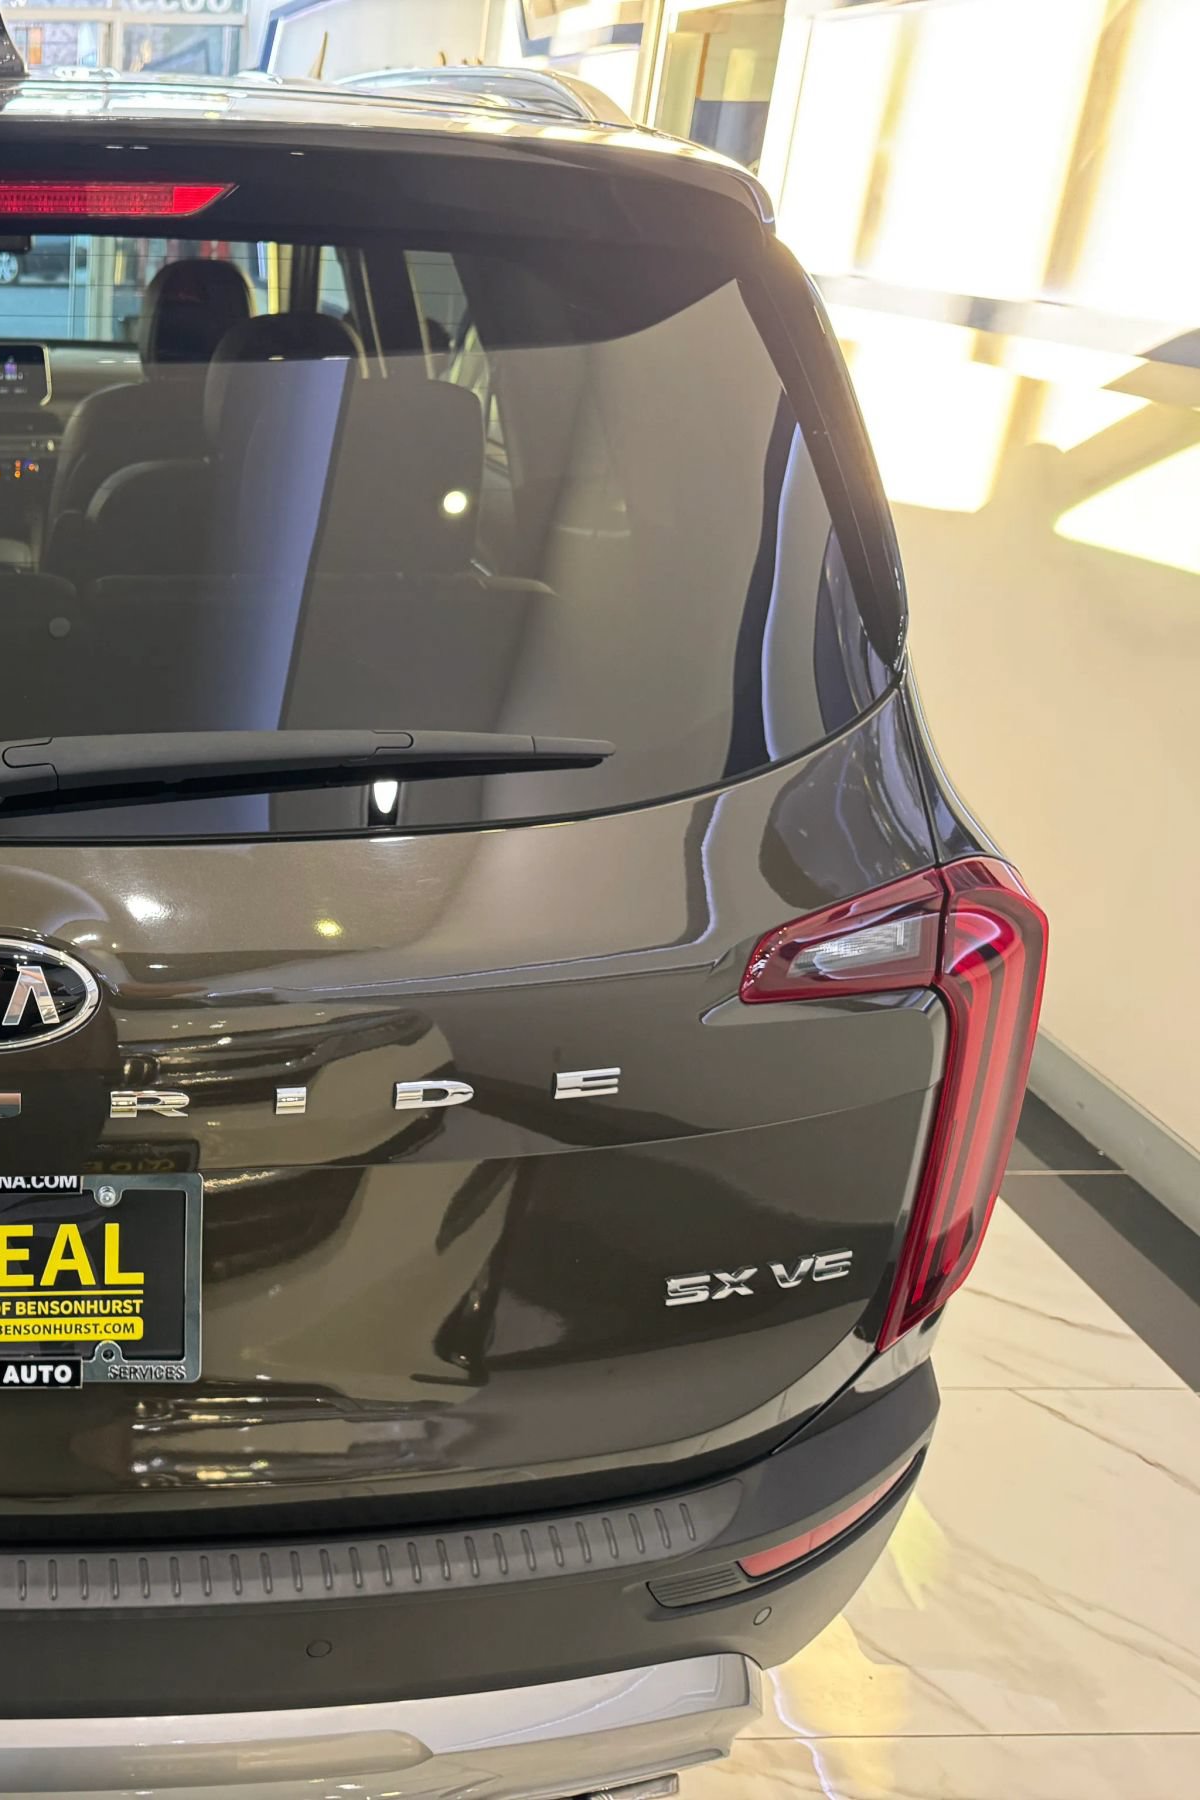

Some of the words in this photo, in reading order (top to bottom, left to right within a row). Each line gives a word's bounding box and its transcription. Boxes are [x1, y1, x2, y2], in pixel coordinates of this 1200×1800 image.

[665, 1266, 758, 1306] SX
[768, 1249, 853, 1289] V6
[15, 1300, 144, 1315] BENSONHURST
[3, 1365, 72, 1384] AUTO
[108, 1365, 186, 1380] SERVICES
